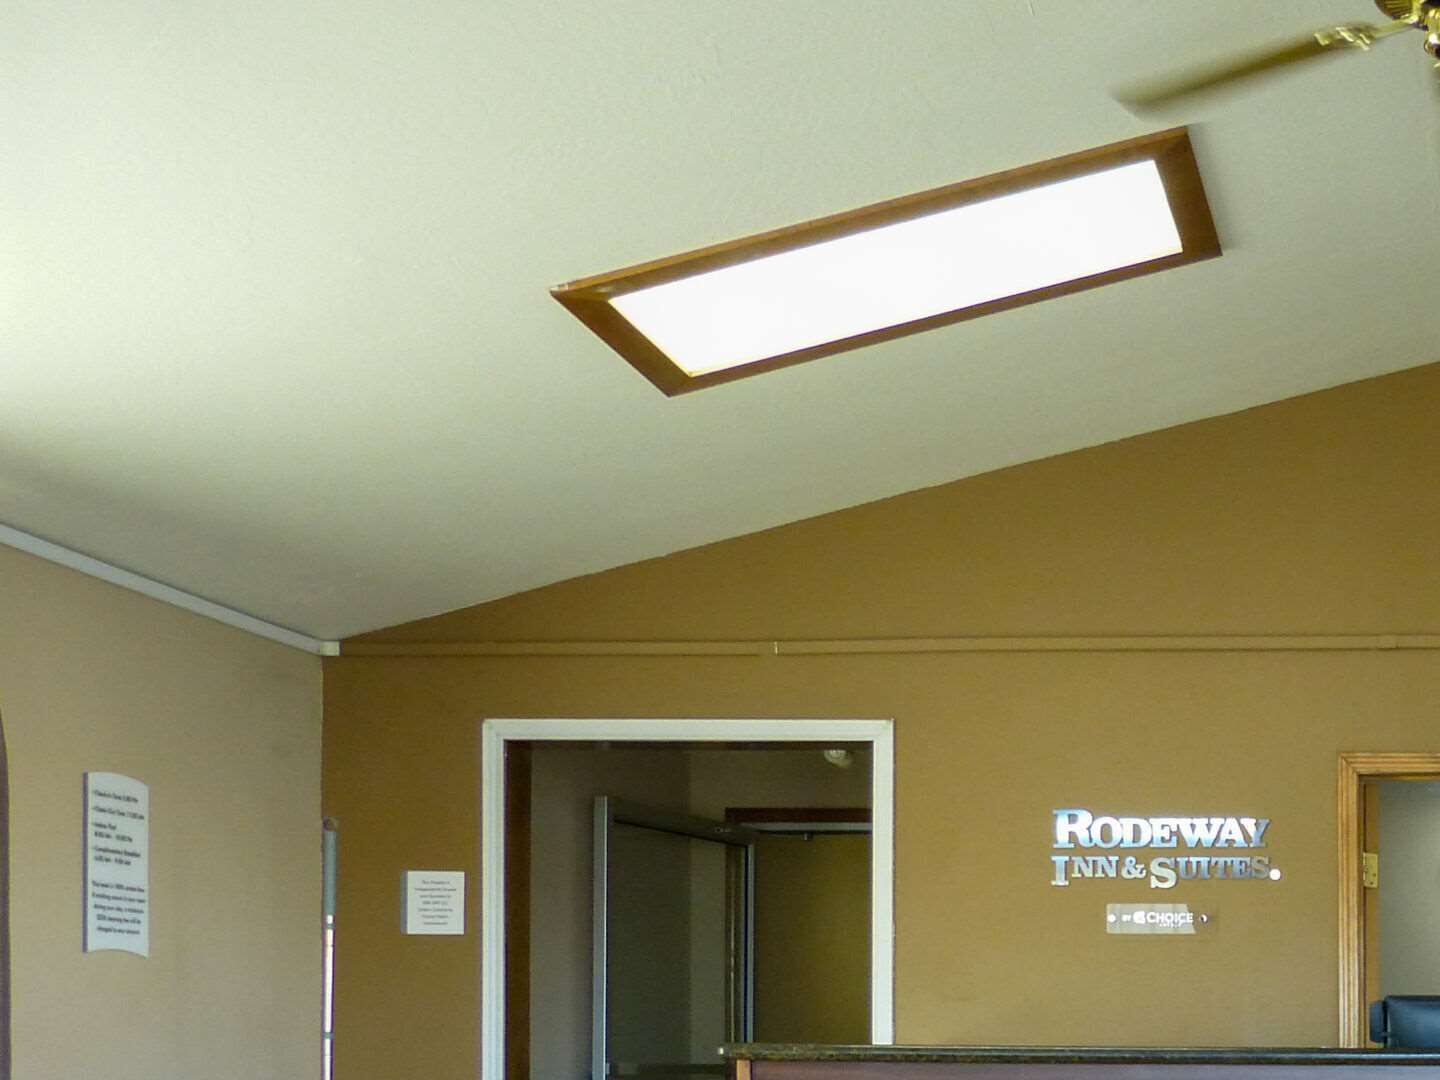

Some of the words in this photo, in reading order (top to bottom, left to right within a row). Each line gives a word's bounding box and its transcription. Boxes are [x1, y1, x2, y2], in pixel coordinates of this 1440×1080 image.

[1052, 808, 1271, 849] RODEWAY
[1051, 855, 1120, 886] INN
[1147, 911, 1194, 924] CHOICE
